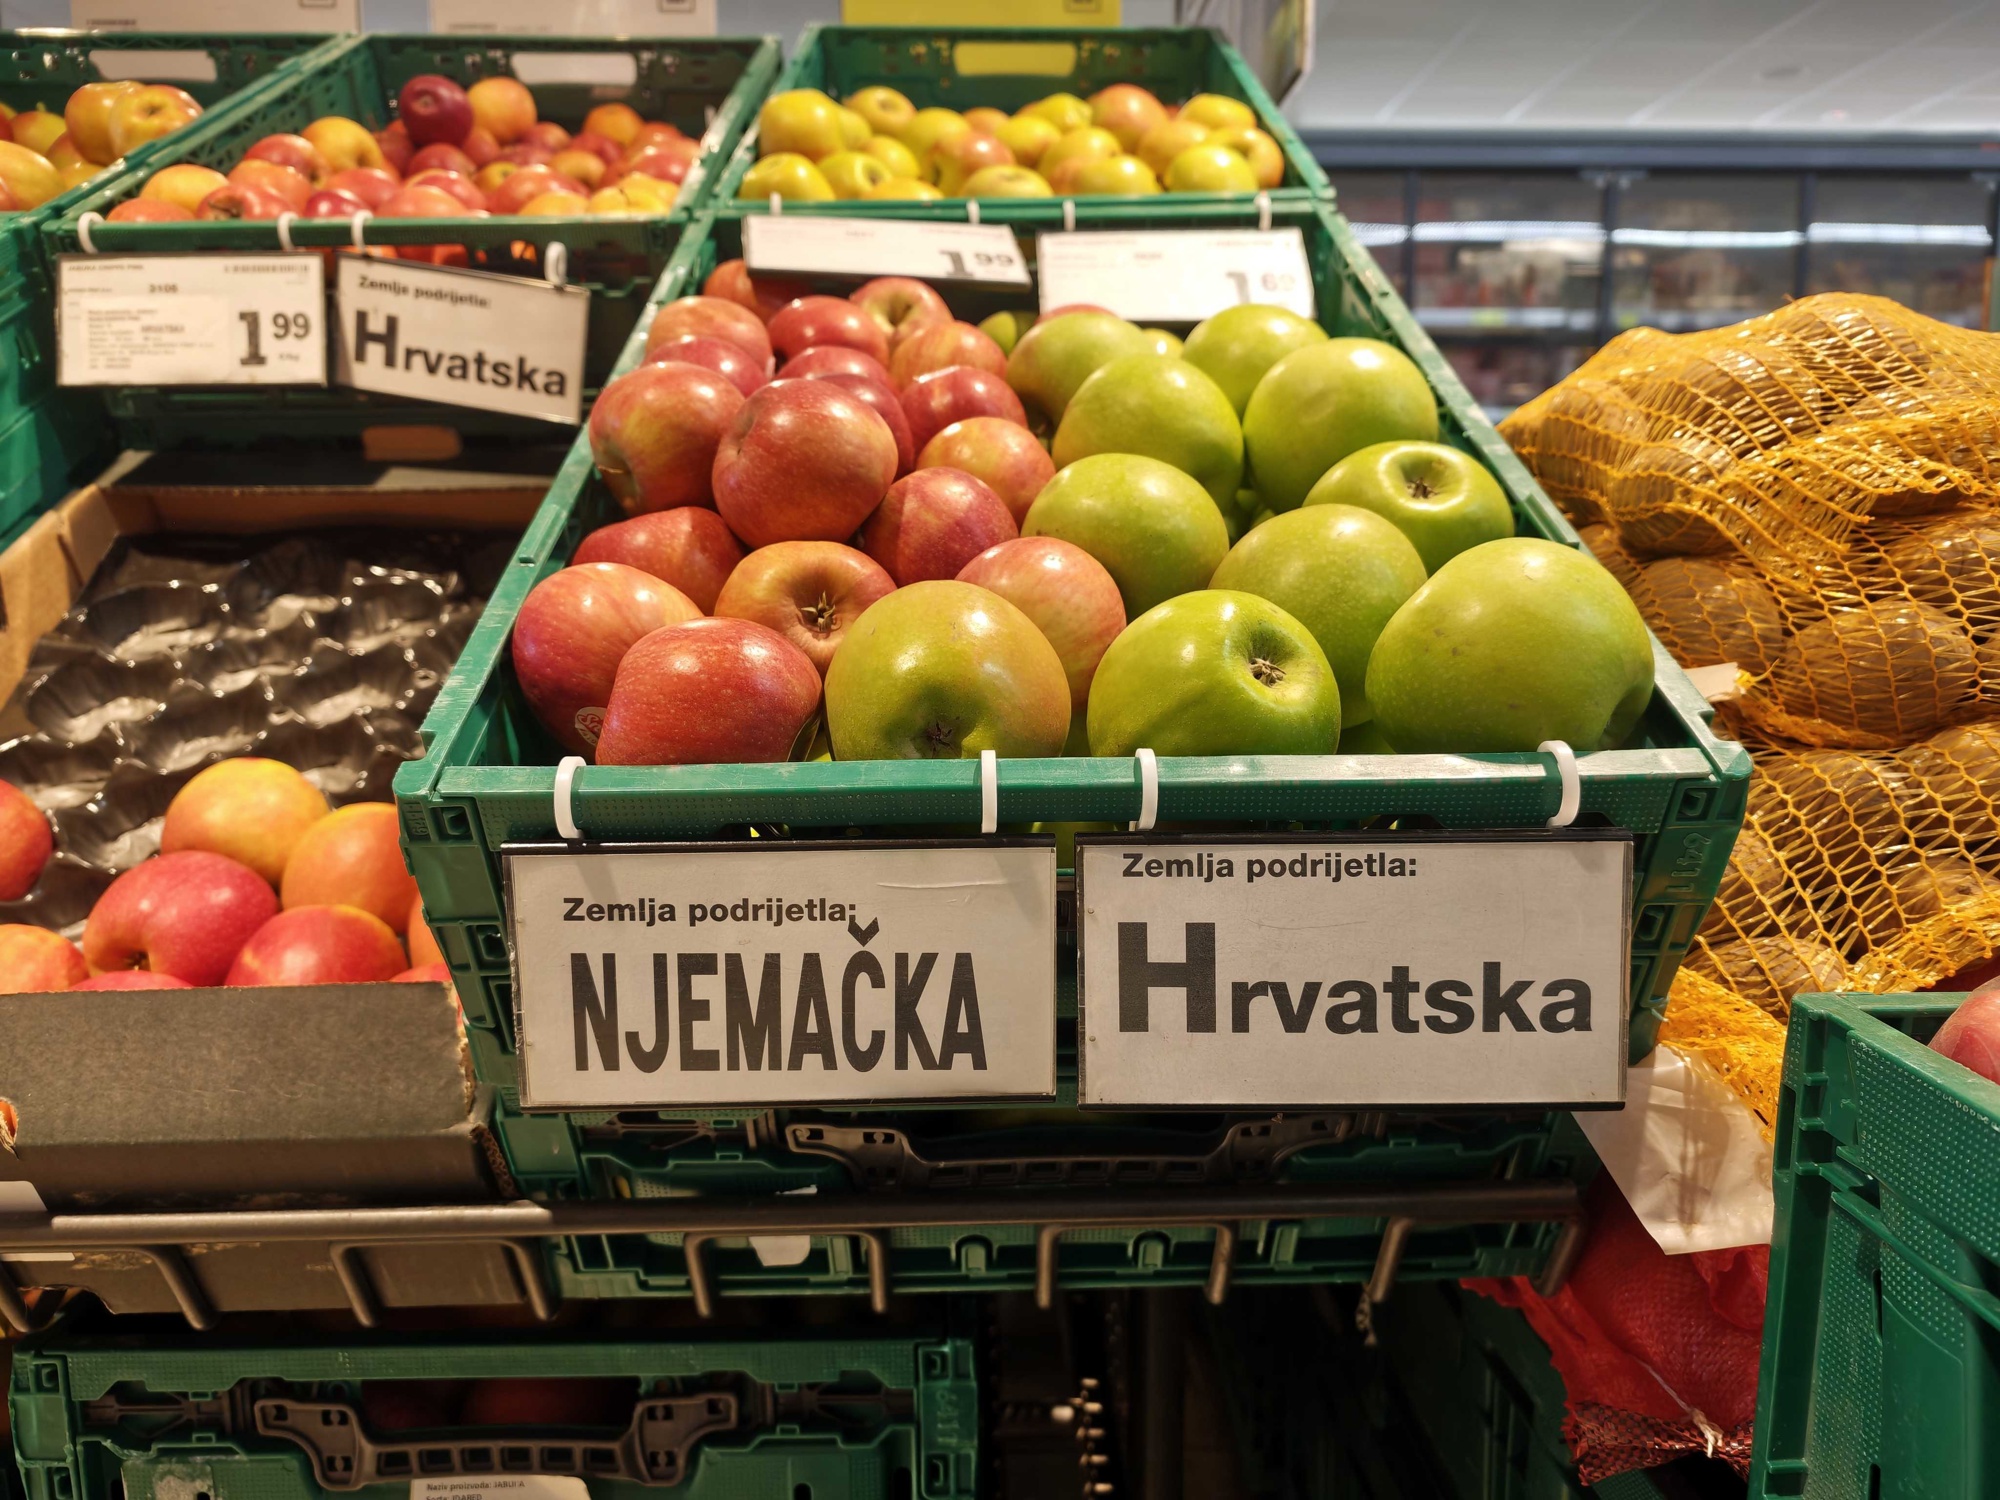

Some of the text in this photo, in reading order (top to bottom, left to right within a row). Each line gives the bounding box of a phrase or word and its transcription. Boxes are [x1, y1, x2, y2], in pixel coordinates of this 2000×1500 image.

[359, 275, 409, 297] Zemlja
[238, 311, 268, 366] 1
[272, 312, 311, 340] 99
[354, 309, 567, 397] Hrvatska
[1122, 852, 1417, 883] Zemlja podrijetla:
[563, 897, 857, 927] Zemlja podrijetla:
[570, 916, 989, 1074] NJEMAČKA
[1117, 921, 1593, 1035] Hrvatska
[426, 1482, 448, 1491] Naziv
[450, 1481, 492, 1492] proizvoda:
